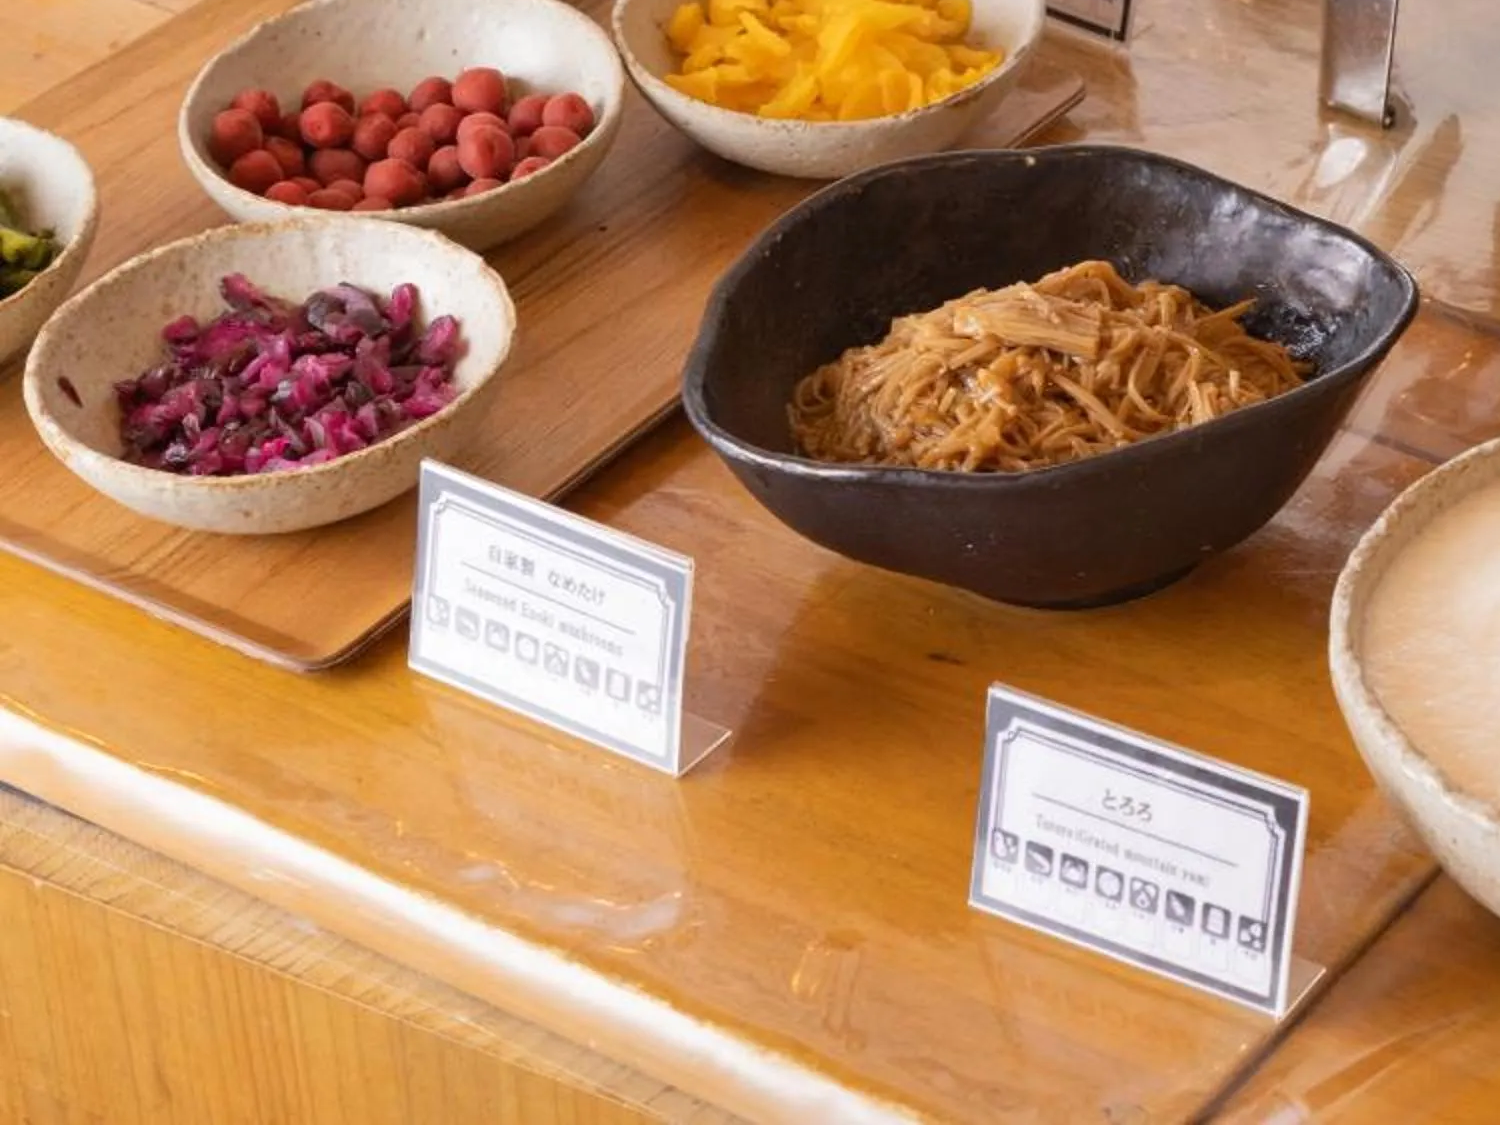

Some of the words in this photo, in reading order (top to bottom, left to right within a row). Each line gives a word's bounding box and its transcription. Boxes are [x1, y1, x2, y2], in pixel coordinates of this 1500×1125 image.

[547, 567, 607, 606] なめたけ
[1101, 788, 1153, 824] とろろ
